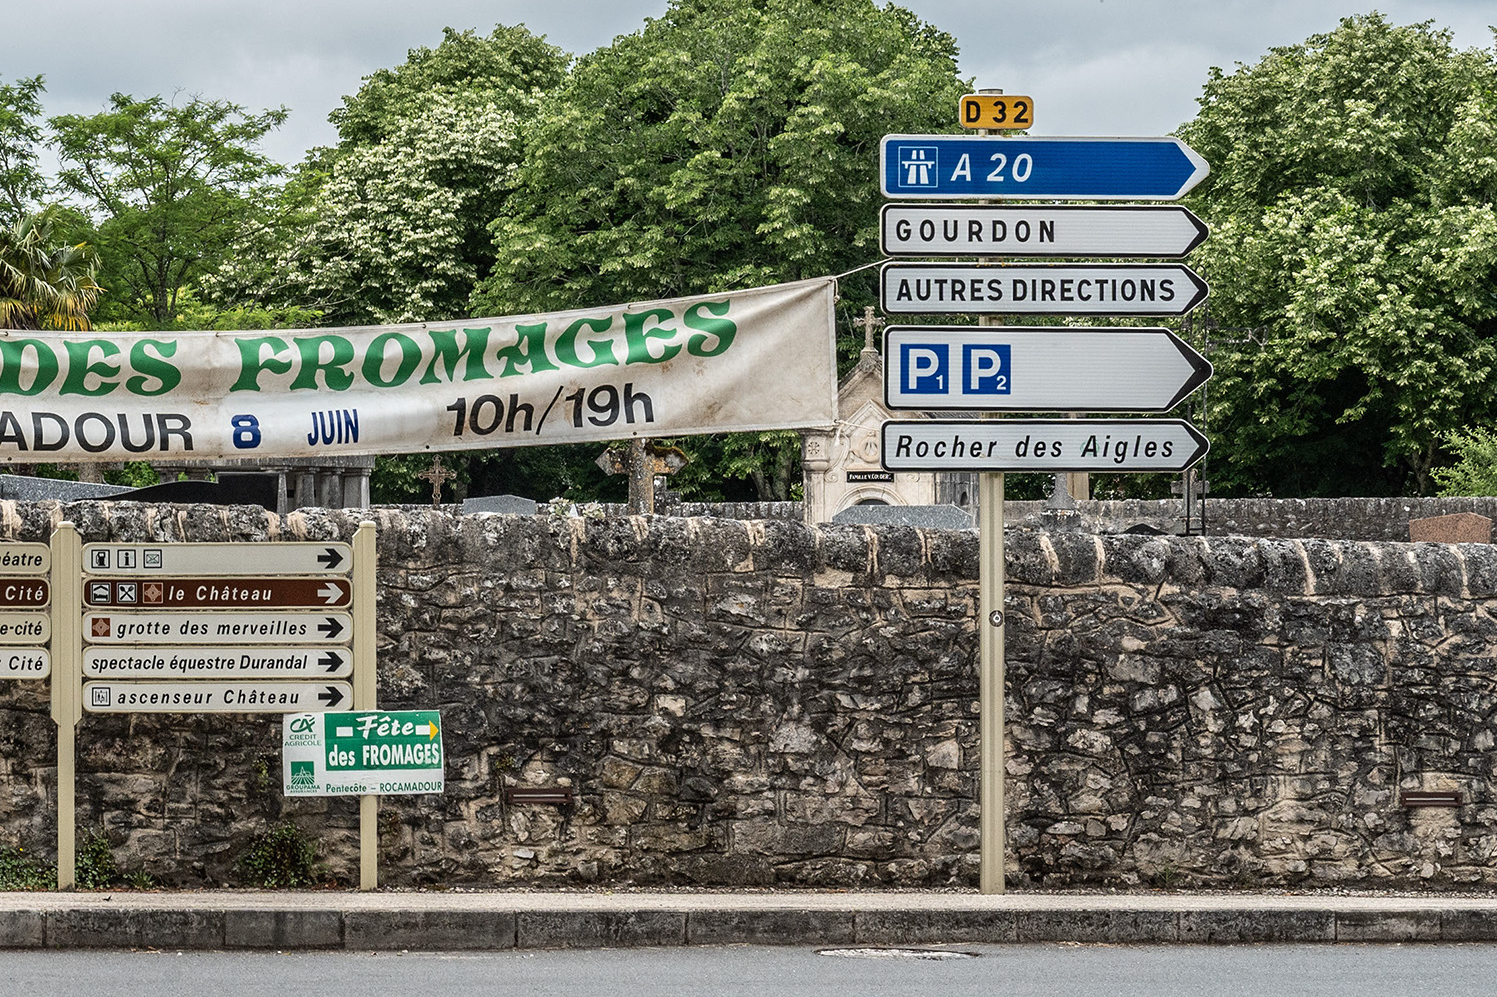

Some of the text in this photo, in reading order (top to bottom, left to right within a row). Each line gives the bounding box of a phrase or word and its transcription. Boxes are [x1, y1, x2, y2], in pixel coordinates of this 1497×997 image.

[966, 101, 1029, 124] D 32
[951, 153, 1033, 182] A 20
[896, 219, 1055, 243] GOURDON
[896, 278, 1175, 302] AUTRES DIRECTIONS
[230, 299, 738, 392] FROMAGES
[230, 413, 261, 450] 8
[307, 408, 359, 446] JUIN
[446, 382, 655, 437] 10h/19h
[895, 434, 1174, 463] Rocher des Aigles
[5, 585, 44, 600] Cité
[168, 585, 272, 601] le Château
[117, 620, 307, 639] grotte des merveilles
[8, 655, 43, 671] Cité
[91, 655, 307, 672] spectacle équestre Durandal
[117, 688, 299, 704] ascenseur Château
[356, 715, 414, 740] Fête
[328, 743, 440, 767] des FROMAGES
[325, 783, 367, 793] Pentecôte
[379, 781, 443, 792] ROCAMADOUR
